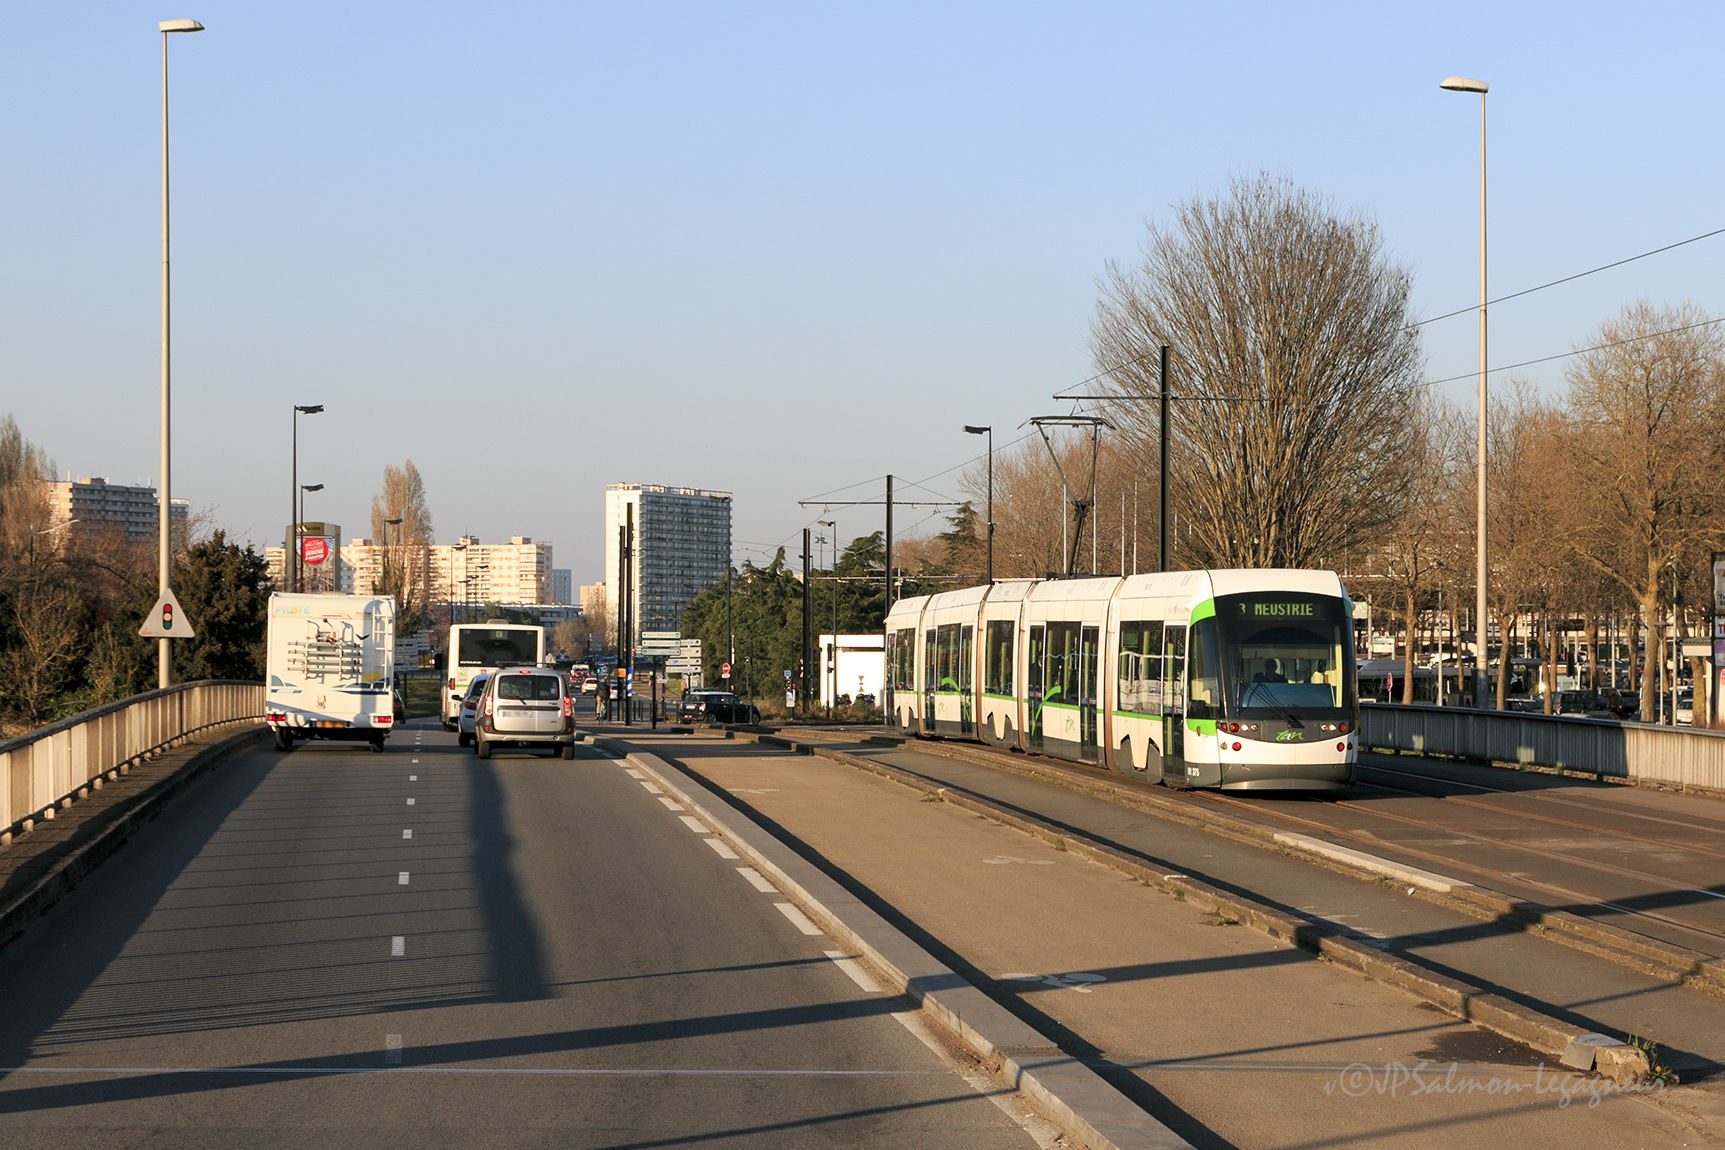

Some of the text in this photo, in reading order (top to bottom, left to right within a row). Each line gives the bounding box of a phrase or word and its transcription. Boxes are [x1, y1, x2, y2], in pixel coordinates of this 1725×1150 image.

[275, 606, 311, 615] PILOTE
[1239, 603, 1314, 616] 3 NEUSTRIE
